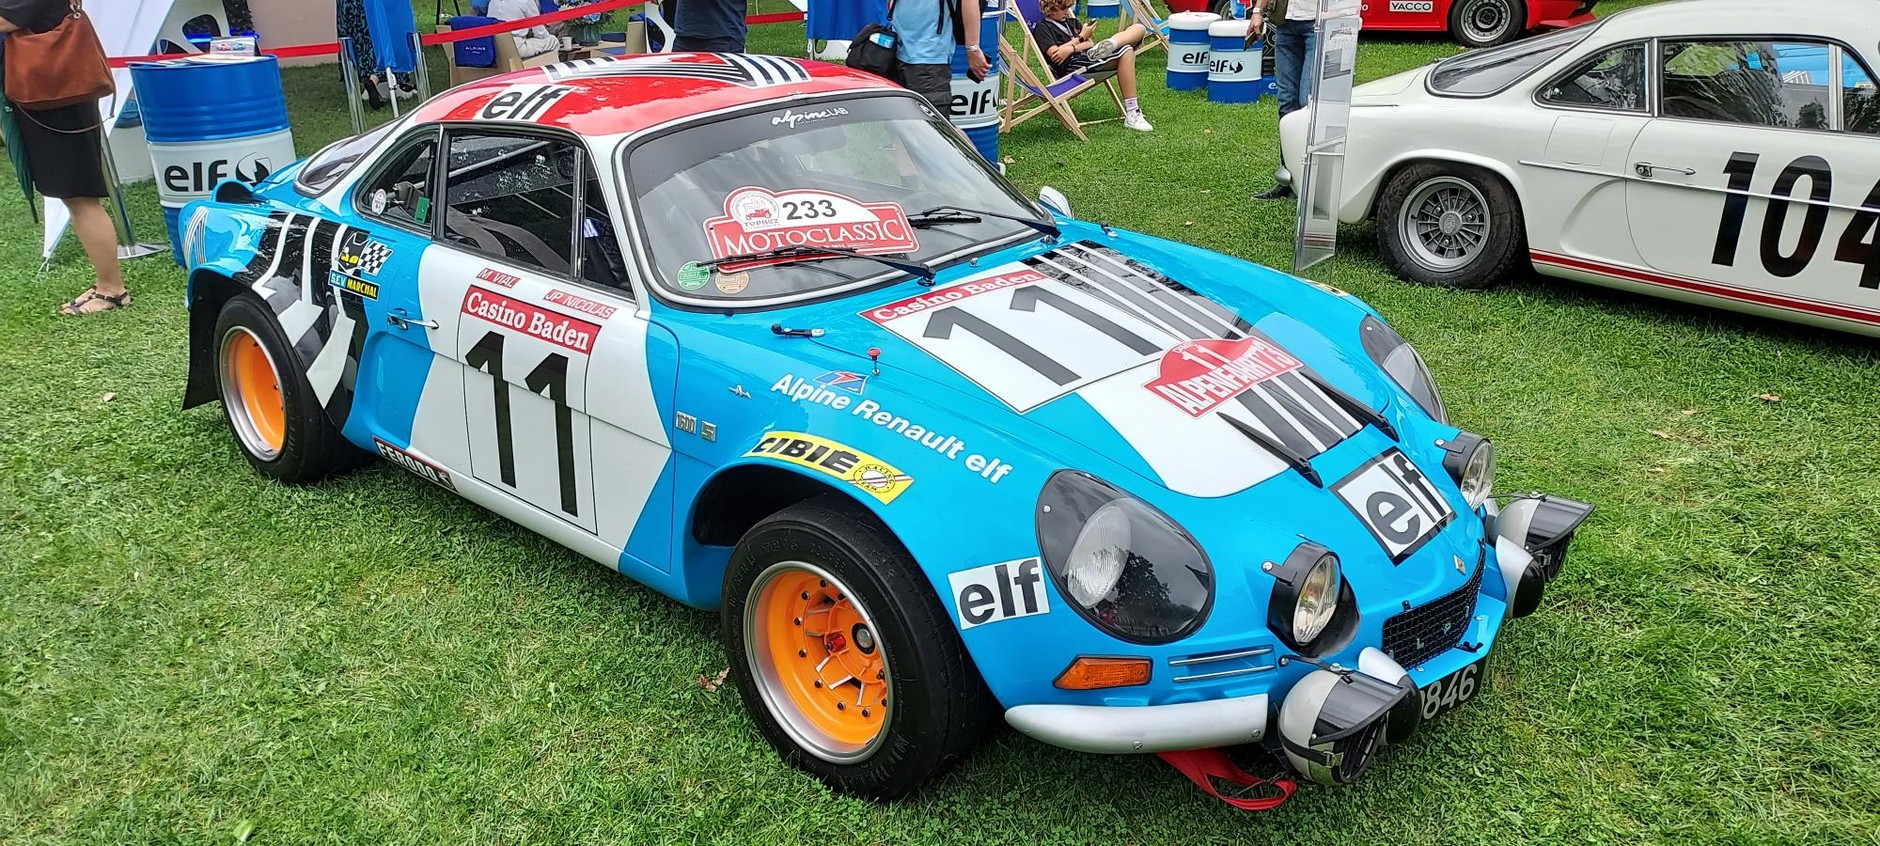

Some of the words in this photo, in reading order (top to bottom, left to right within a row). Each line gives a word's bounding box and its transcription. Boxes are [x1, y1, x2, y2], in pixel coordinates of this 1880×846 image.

[1391, 2, 1432, 11] YACCO
[1182, 51, 1209, 65] elf
[1210, 60, 1229, 72] elf
[482, 85, 572, 119] elf
[950, 88, 992, 116] elf
[164, 159, 228, 192] elf
[782, 199, 837, 221] 233
[1711, 151, 1880, 290] 104
[722, 219, 905, 257] MOTOCLASSIC
[346, 279, 378, 298] MARCHAL
[478, 270, 489, 280] M
[493, 273, 517, 288] VIAL
[545, 290, 561, 302] JP
[563, 295, 615, 318] NICOLAS
[873, 288, 963, 321] Casino
[965, 273, 1038, 295] Baden
[467, 291, 526, 329] Casino
[527, 311, 590, 350] Baden
[922, 284, 1163, 387] 11
[1181, 342, 1233, 373] 11
[465, 330, 578, 518] 11
[702, 421, 717, 443] S
[770, 373, 852, 411] Alpine
[852, 399, 966, 461] Renault
[964, 453, 1014, 485] elf
[376, 441, 439, 482] FERODO
[1366, 453, 1447, 545] elf
[959, 558, 1041, 625] elf
[1419, 663, 1478, 720] 846
